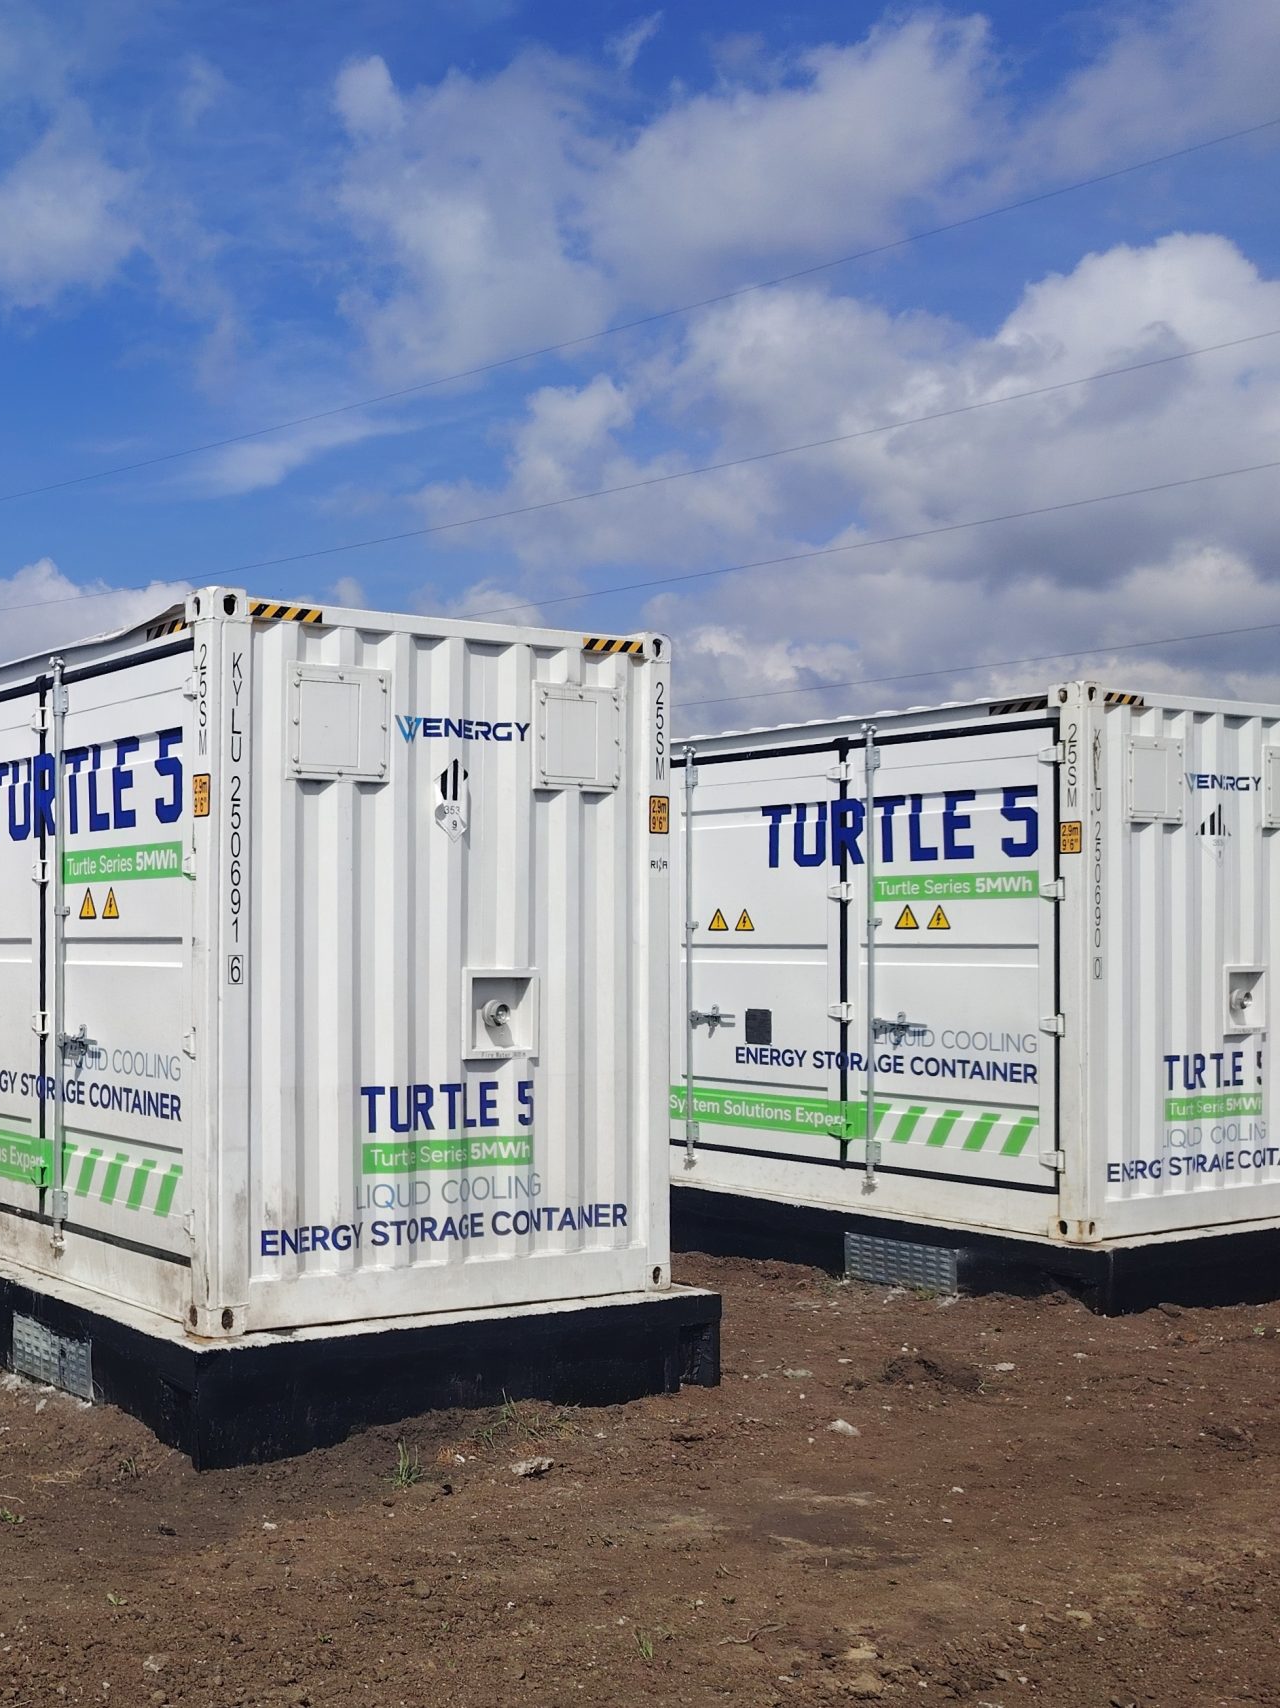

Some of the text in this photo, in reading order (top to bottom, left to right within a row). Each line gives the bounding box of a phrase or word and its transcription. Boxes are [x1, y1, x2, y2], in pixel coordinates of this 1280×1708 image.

[199, 643, 208, 756] 25SM
[394, 714, 531, 744] WENERGY
[656, 681, 665, 781] 25SM
[154, 726, 183, 824] 5
[231, 651, 243, 982] KYLU 250691 6
[452, 820, 458, 828] 9
[761, 784, 1039, 868] TURTLE 5
[67, 849, 178, 876] Turtle Series 5MWh
[878, 876, 1033, 896] Turtle Series 5MWh
[941, 1030, 1038, 1054] COOLING
[112, 1049, 181, 1082] COOLING
[735, 1046, 807, 1068] ENERGY
[910, 1056, 1038, 1085] CONTAINER
[89, 1082, 182, 1121] CONTAINER
[360, 1080, 534, 1133] TURTLE 5
[724, 1100, 792, 1122] Solutions
[356, 1173, 541, 1210] LIQUID COOLING
[260, 1203, 628, 1257] ENERGY STORAGE CONTAINER
